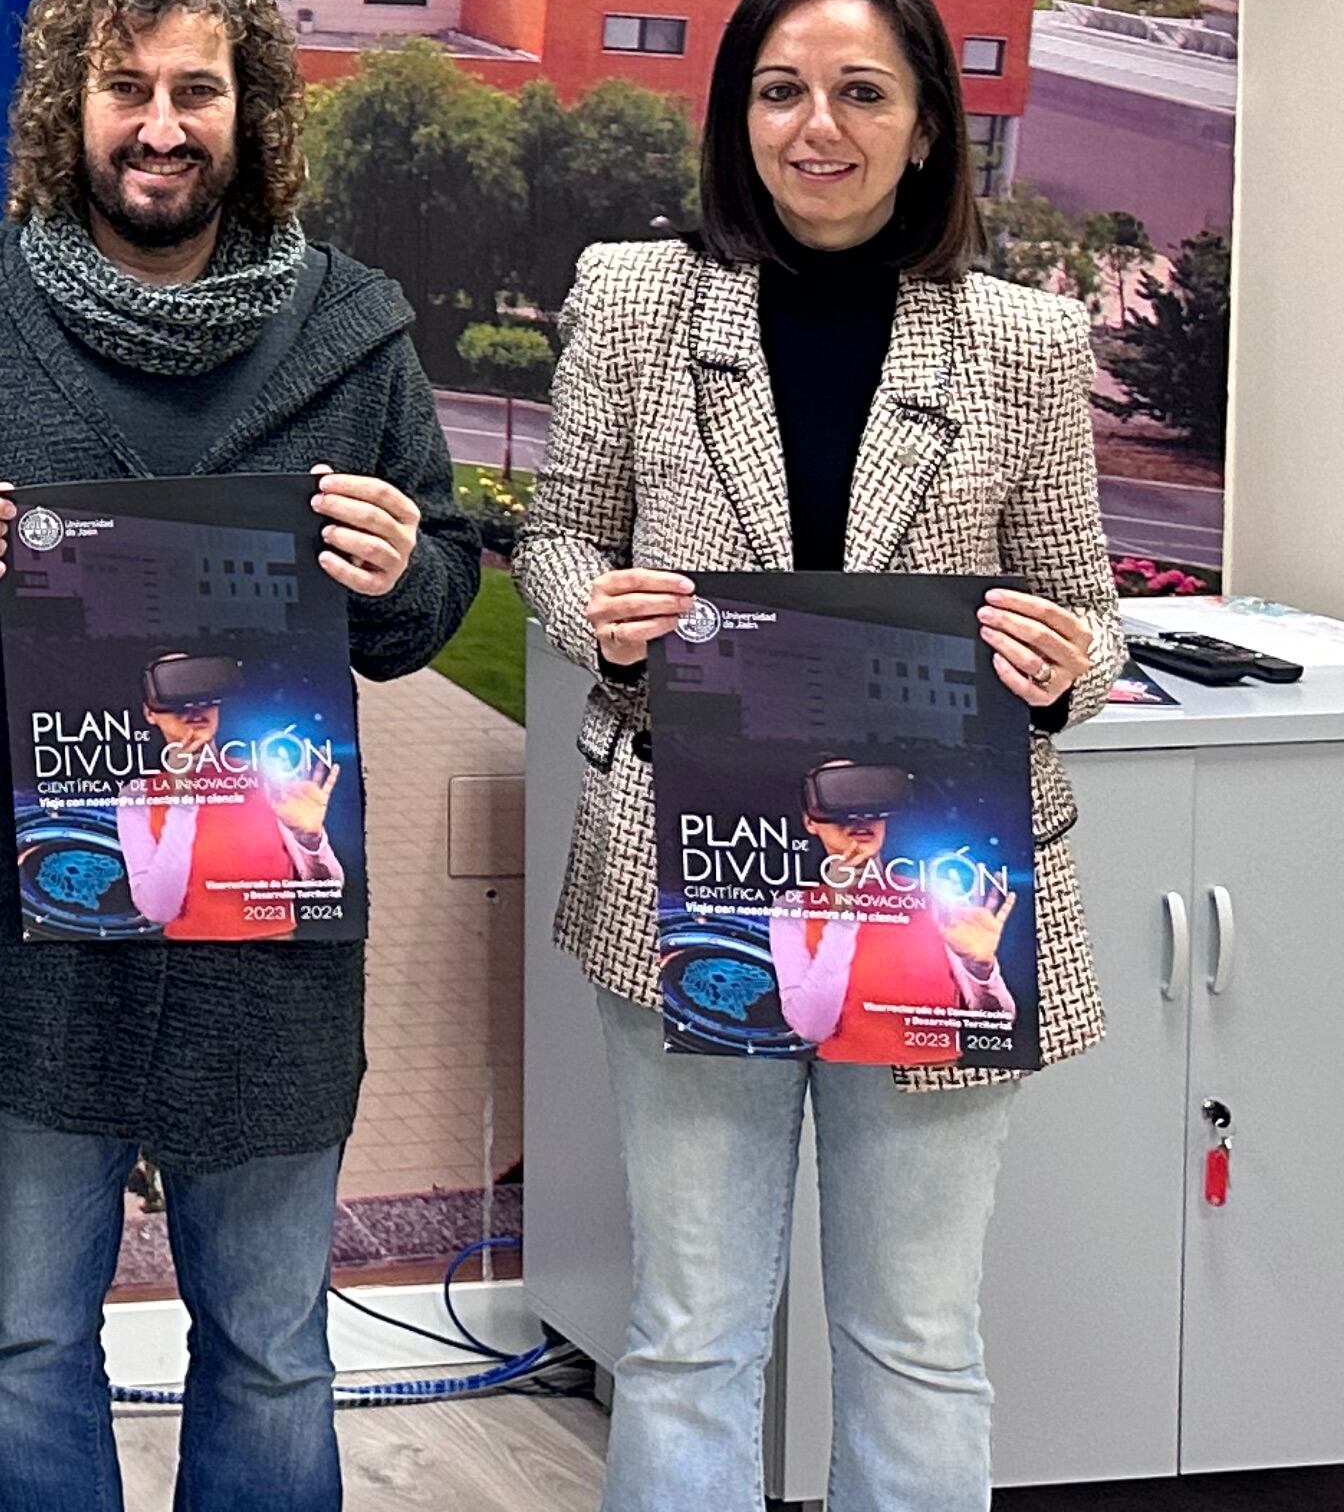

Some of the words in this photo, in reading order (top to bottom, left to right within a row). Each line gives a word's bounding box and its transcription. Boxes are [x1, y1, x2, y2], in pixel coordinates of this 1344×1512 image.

[32, 710, 130, 742] PLAN
[134, 731, 150, 741] DE
[34, 725, 332, 777] DIVULGACIÓN
[38, 779, 111, 794] CIENTÍFICA
[116, 782, 124, 792] Y
[130, 781, 147, 791] DE
[153, 780, 170, 791] LA
[175, 775, 258, 790] INNOVACIÓN
[681, 815, 788, 852] PLAN
[792, 840, 809, 851] DE
[682, 846, 1008, 896] DIVULGACIÓN
[684, 884, 764, 901] CIENTÍFICA
[770, 891, 779, 902] Y
[786, 891, 804, 903] DE
[811, 893, 829, 904] LA
[835, 893, 926, 909] INNOVACIÓN
[244, 906, 285, 920] 2023
[301, 906, 343, 920] 2024
[904, 1032, 950, 1047] 2023
[967, 1036, 1012, 1050] 2024
